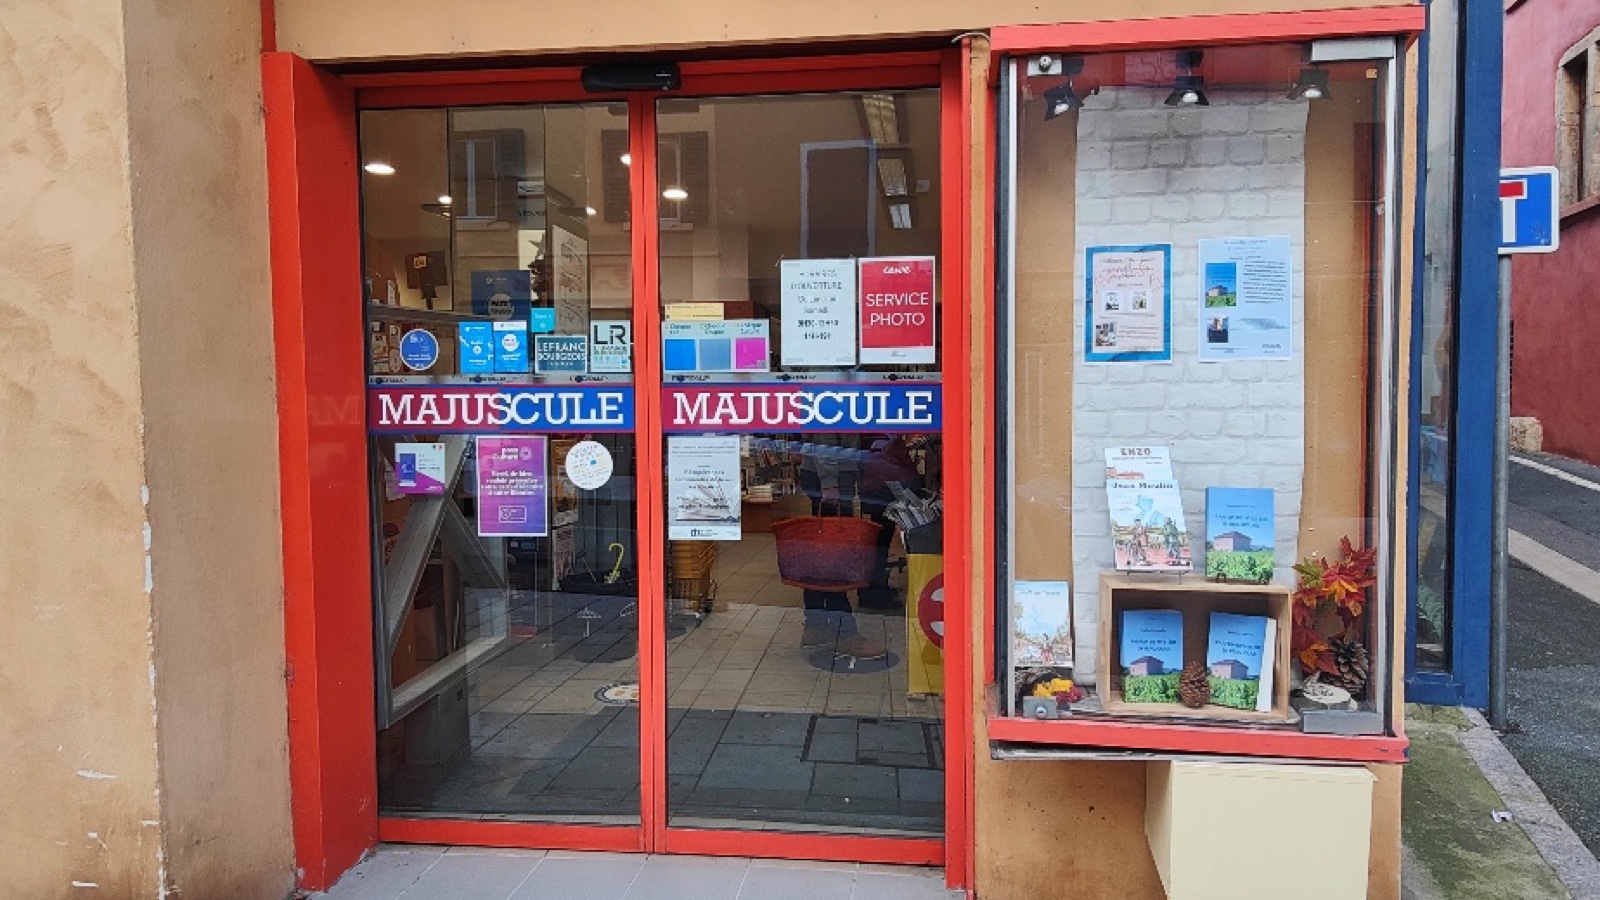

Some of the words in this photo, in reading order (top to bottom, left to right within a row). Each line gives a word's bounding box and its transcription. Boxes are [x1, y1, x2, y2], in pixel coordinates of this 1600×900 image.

[865, 292, 929, 307] SERVICE
[870, 311, 926, 326] PHOTO
[537, 342, 586, 352] LEFRANC
[378, 392, 625, 426] MAJUSCULE
[673, 391, 933, 426] MAJUSCULE
